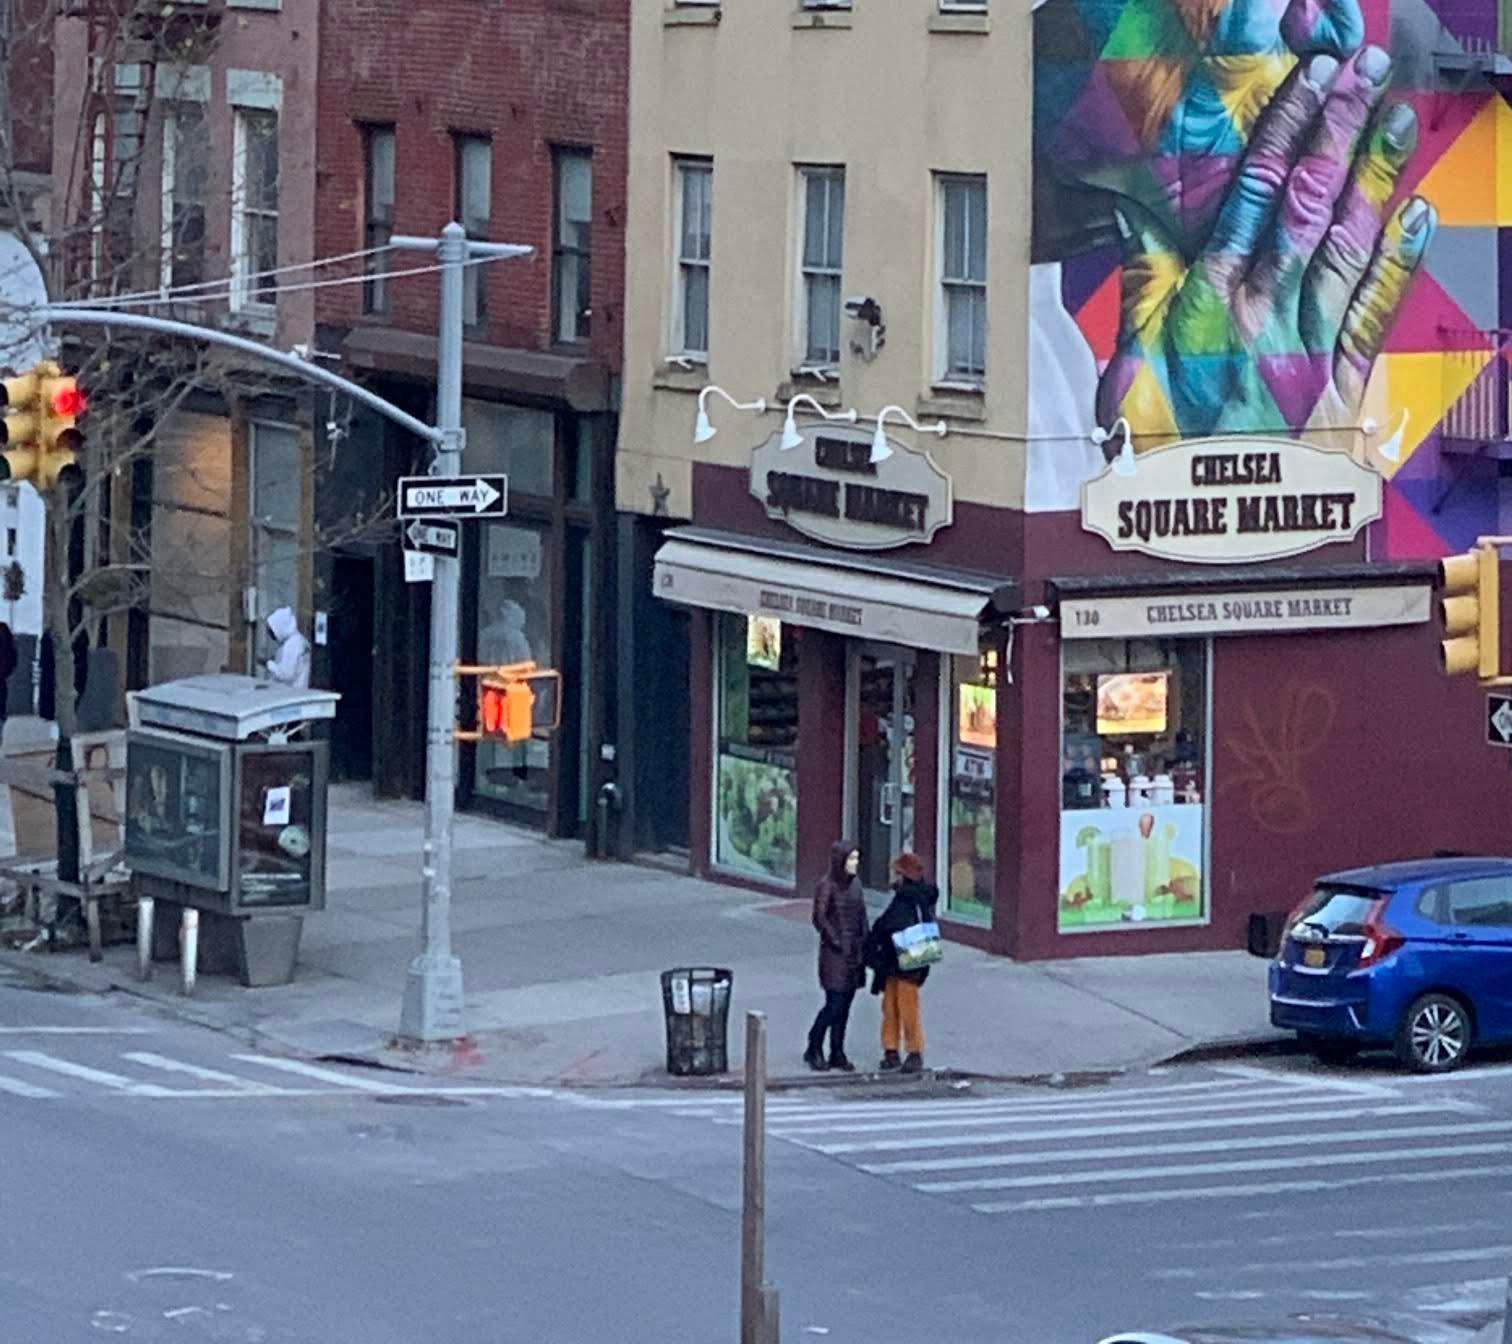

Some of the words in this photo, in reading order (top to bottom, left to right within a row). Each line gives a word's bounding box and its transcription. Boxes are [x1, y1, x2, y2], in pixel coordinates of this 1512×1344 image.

[1191, 453, 1282, 486] CHELSEA
[414, 490, 445, 506] ONE
[459, 489, 489, 503] WAY
[1117, 497, 1228, 542] SQUARE
[1236, 493, 1356, 534] MARKET
[1146, 604, 1218, 624] CHELSEA
[1222, 600, 1284, 621] SQUARE
[1287, 597, 1352, 617] MARKET
